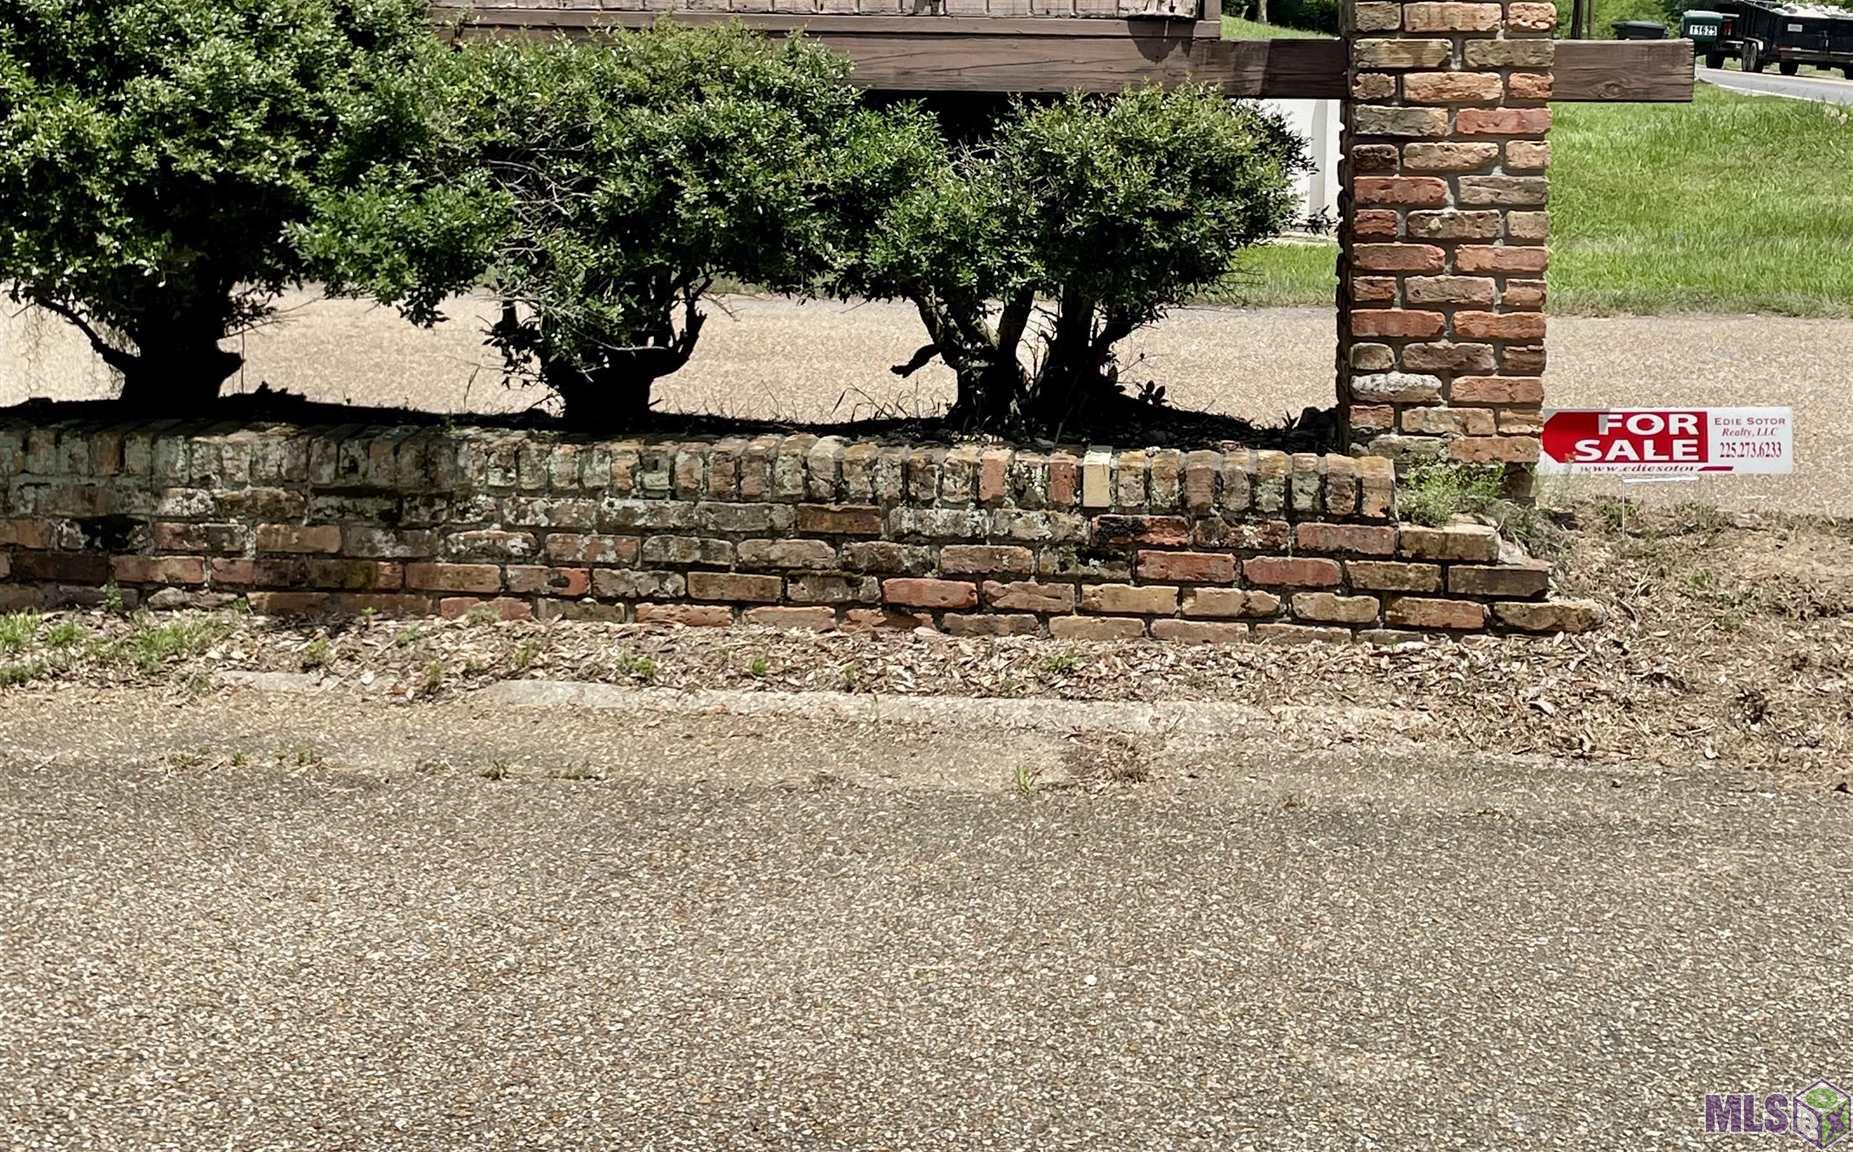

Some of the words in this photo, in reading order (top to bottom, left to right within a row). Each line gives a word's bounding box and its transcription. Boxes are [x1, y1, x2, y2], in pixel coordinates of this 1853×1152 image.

[1598, 413, 1699, 436] FOR
[1574, 439, 1699, 461] SALE
[1719, 441, 1782, 459] 225.273.6233
